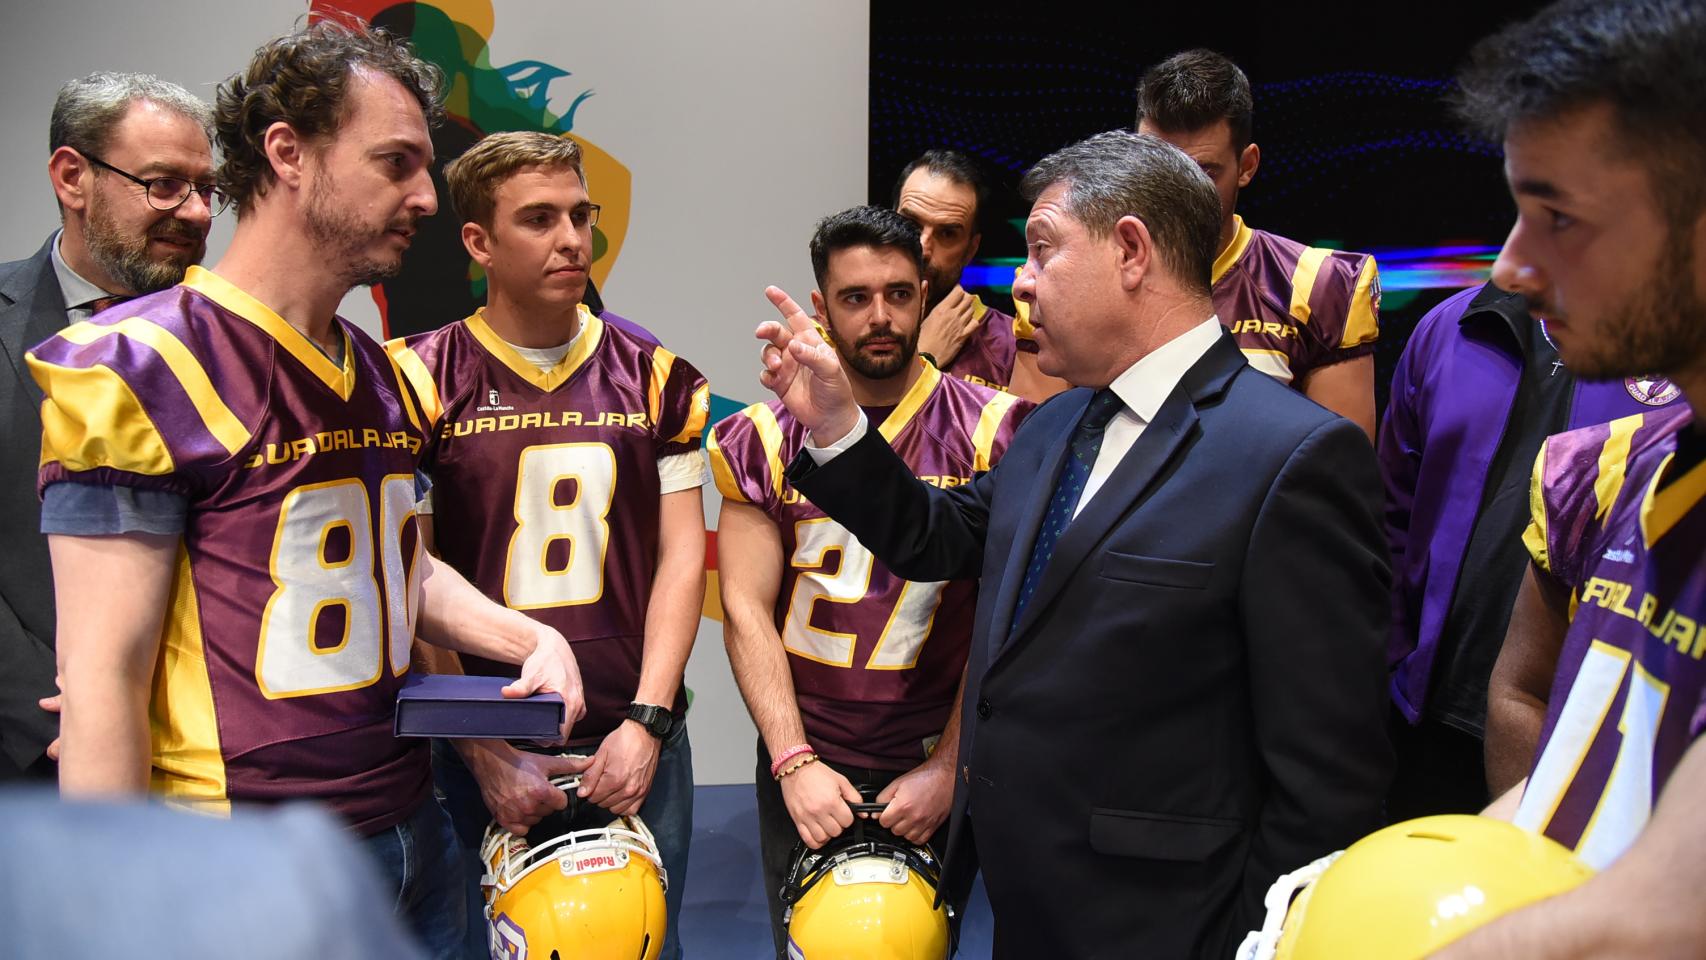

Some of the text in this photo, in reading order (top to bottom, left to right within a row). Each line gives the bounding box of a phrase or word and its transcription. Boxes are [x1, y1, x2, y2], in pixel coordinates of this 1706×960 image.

[441, 411, 650, 439] GUADALAJAR
[504, 442, 617, 610] 8
[255, 473, 422, 700] 80
[576, 856, 615, 871] Riddell
